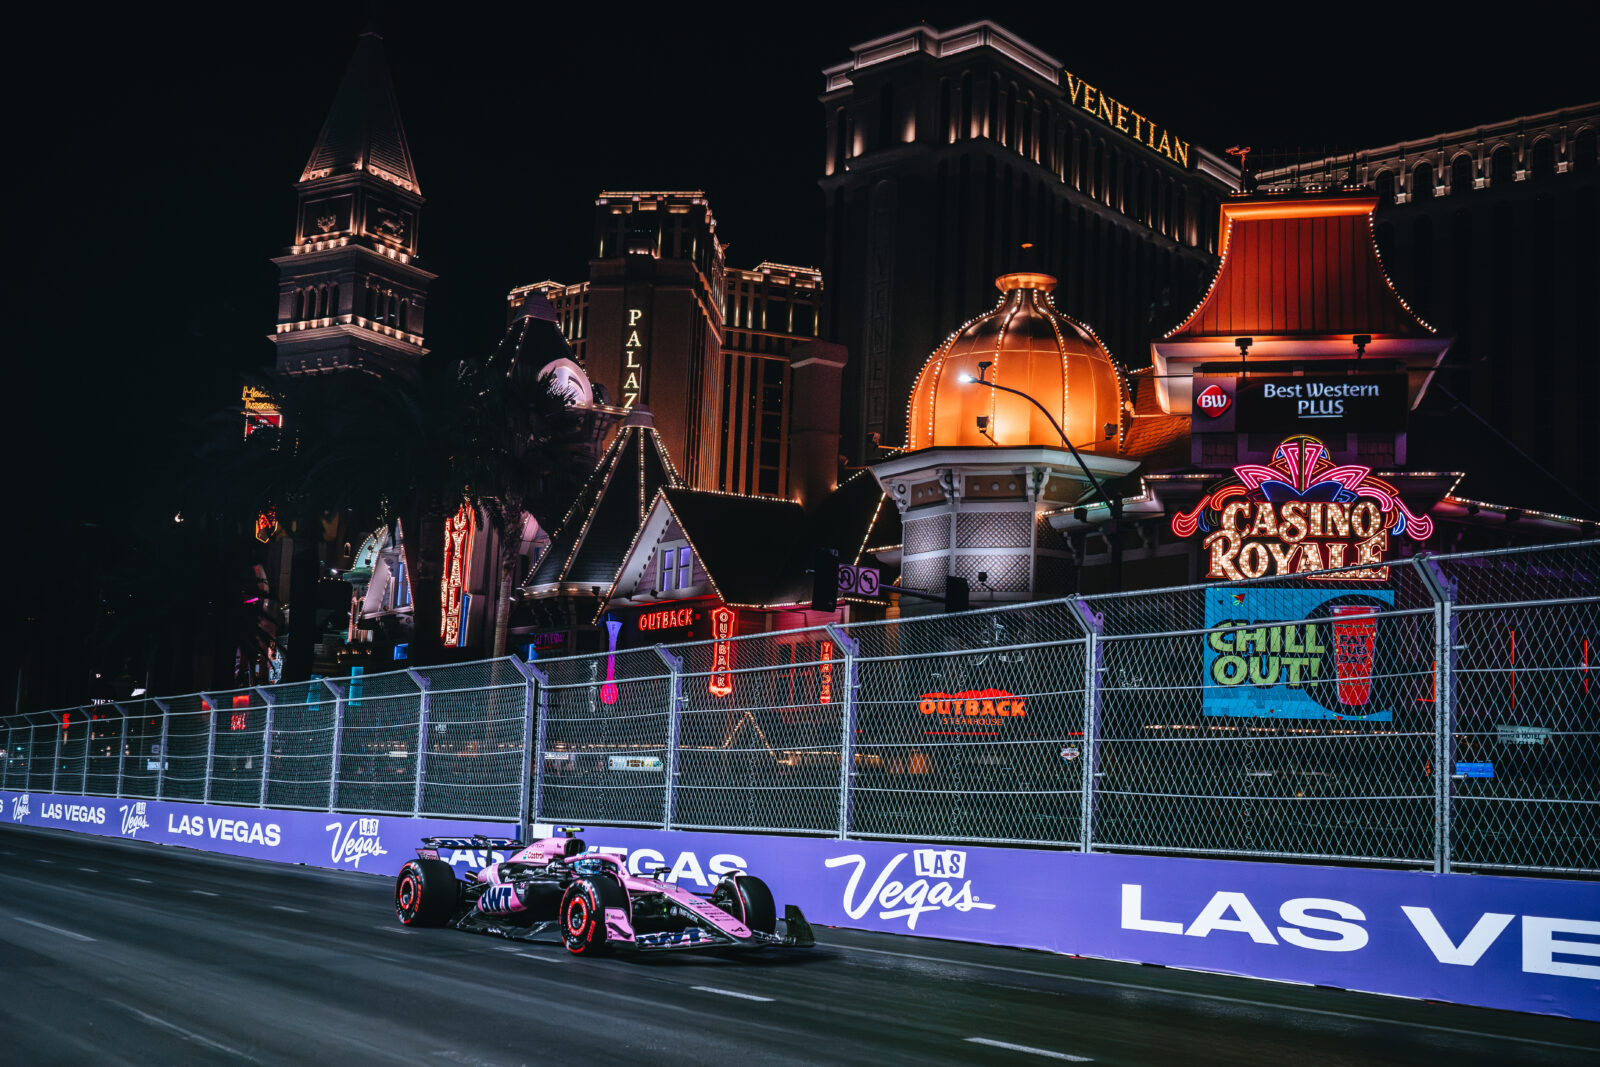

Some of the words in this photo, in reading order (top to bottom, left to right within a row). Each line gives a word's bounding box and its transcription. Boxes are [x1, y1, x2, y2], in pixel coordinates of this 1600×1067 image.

[1064, 70, 1190, 168] VENETIAN
[1201, 394, 1228, 409] BW
[1263, 383, 1303, 398] Best
[1306, 382, 1380, 398] Western
[1297, 399, 1344, 416] PLUS
[1220, 501, 1382, 543] CASINO
[1203, 528, 1389, 581] ROYALE
[638, 607, 694, 632] OUTBACK
[1209, 620, 1325, 653] CHILL
[1339, 634, 1370, 645] FAT
[1338, 645, 1369, 655] TUES
[1338, 655, 1369, 664] DAY
[1213, 655, 1321, 687] OUT!
[918, 698, 1027, 718] OUTBACK
[942, 717, 1004, 726] STEAKHOUSE
[41, 802, 63, 820] LAS
[64, 804, 106, 825] VEGAS
[119, 803, 150, 838] Vegas
[167, 813, 204, 836] LAS
[207, 816, 281, 847] VEGAS
[360, 819, 379, 836] LAS
[325, 820, 388, 869] Vegas
[917, 851, 964, 877] LAS
[480, 886, 513, 914] BWT
[824, 852, 997, 931] Vegas
[1120, 882, 1370, 953] LAS
[1400, 905, 1600, 980] VE
